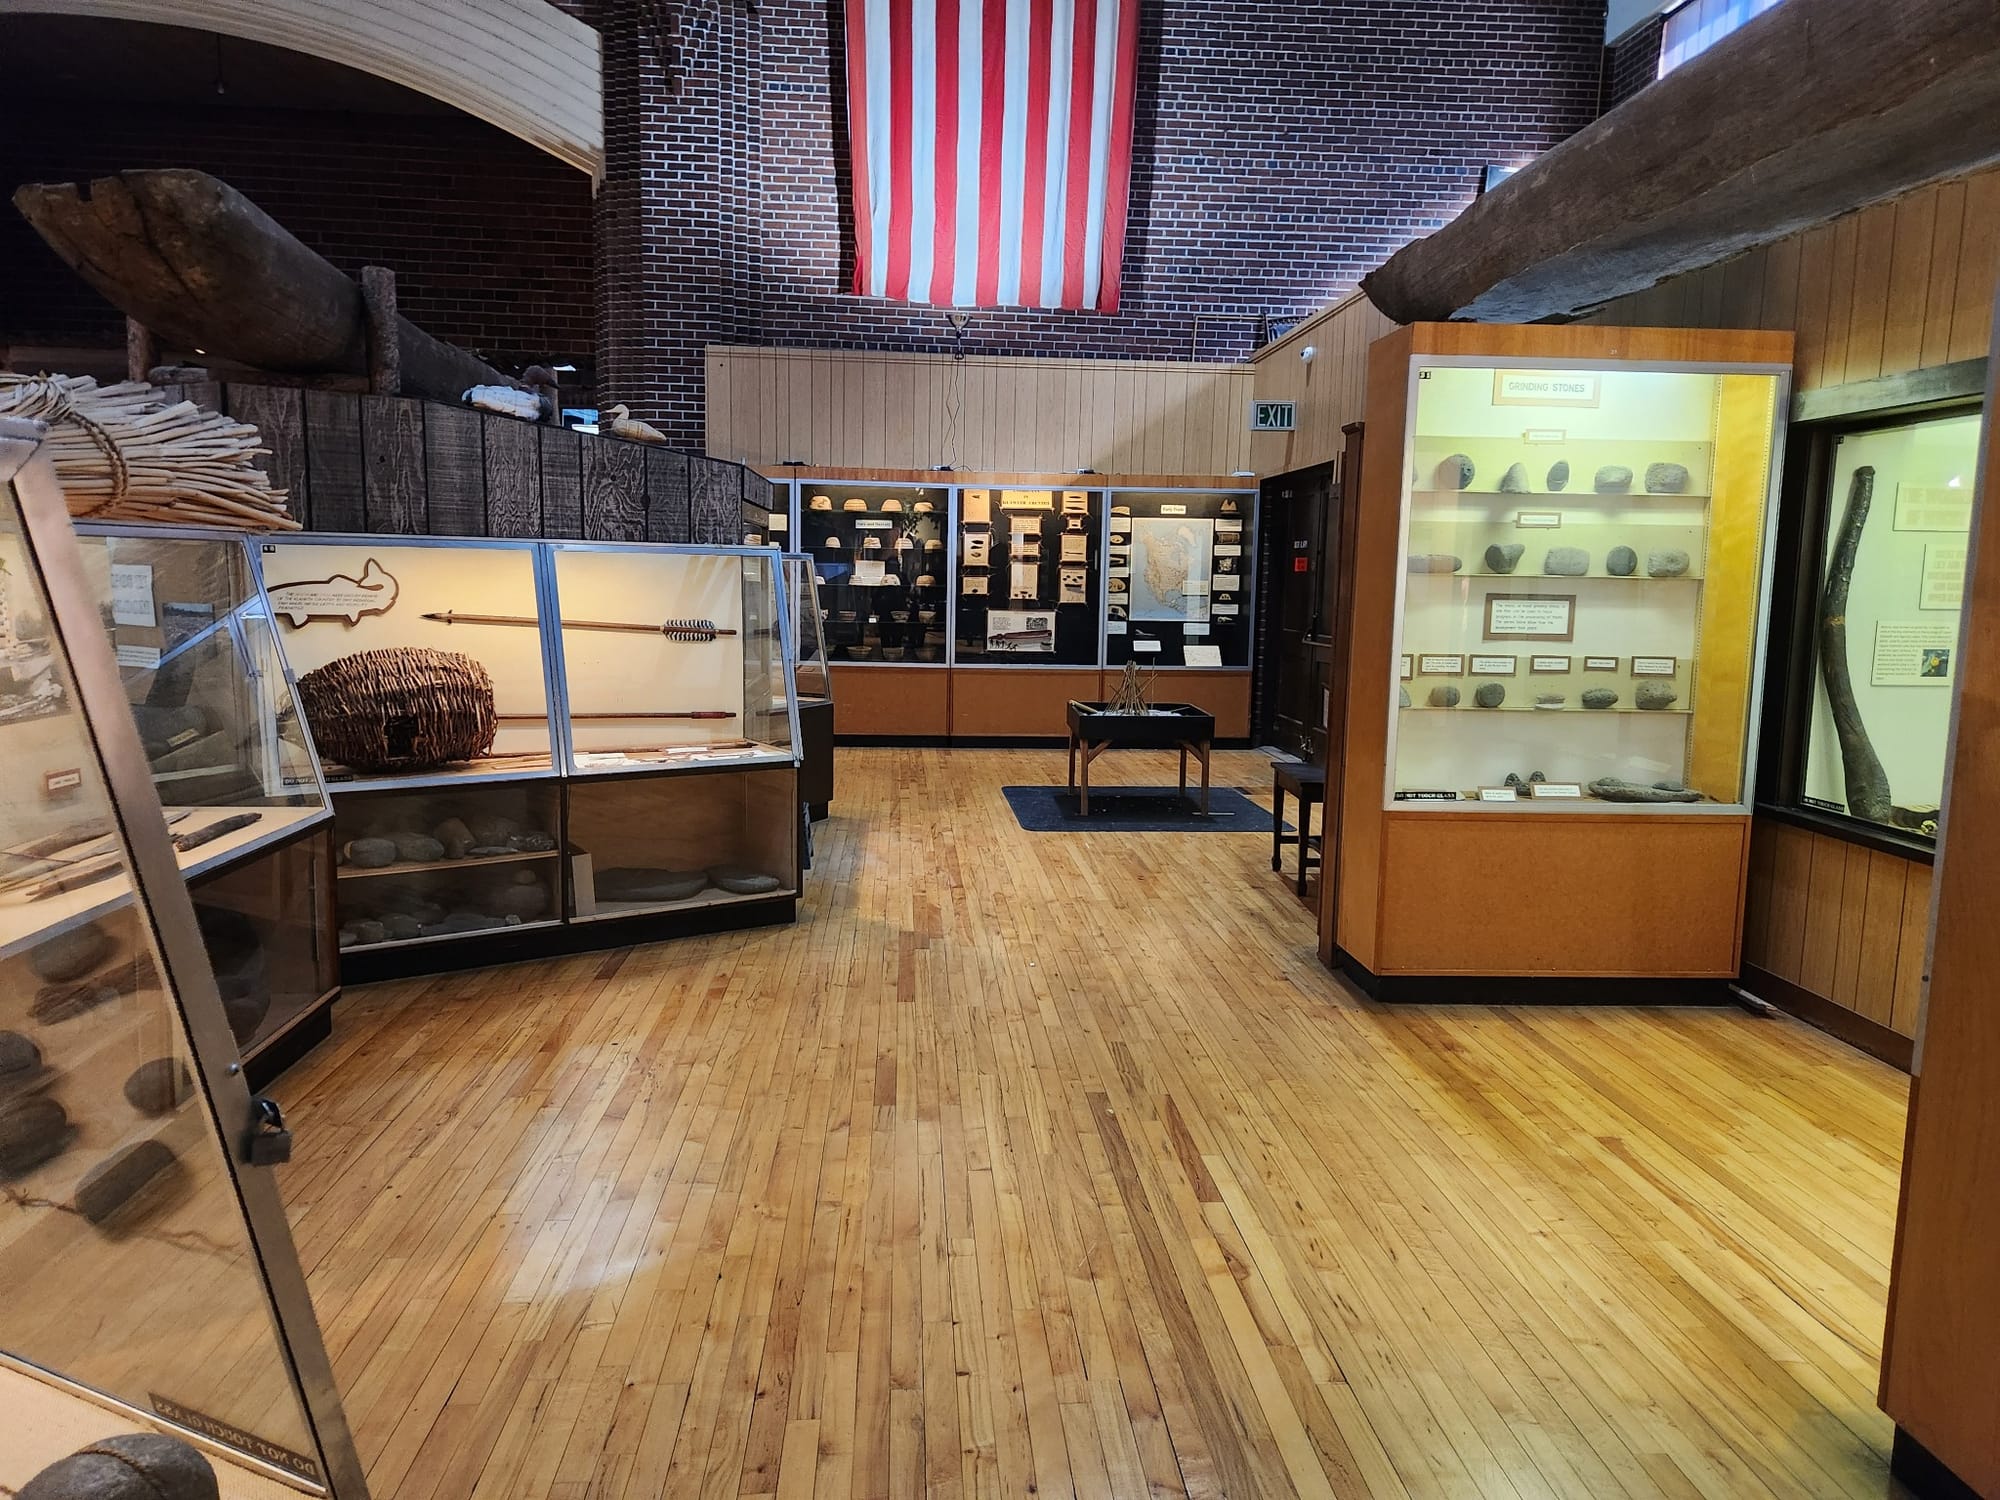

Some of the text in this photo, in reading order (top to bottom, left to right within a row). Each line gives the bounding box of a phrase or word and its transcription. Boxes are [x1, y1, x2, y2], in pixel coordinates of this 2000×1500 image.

[1508, 381, 1585, 393] GRINDING STONES
[1257, 405, 1292, 428] EXIT
